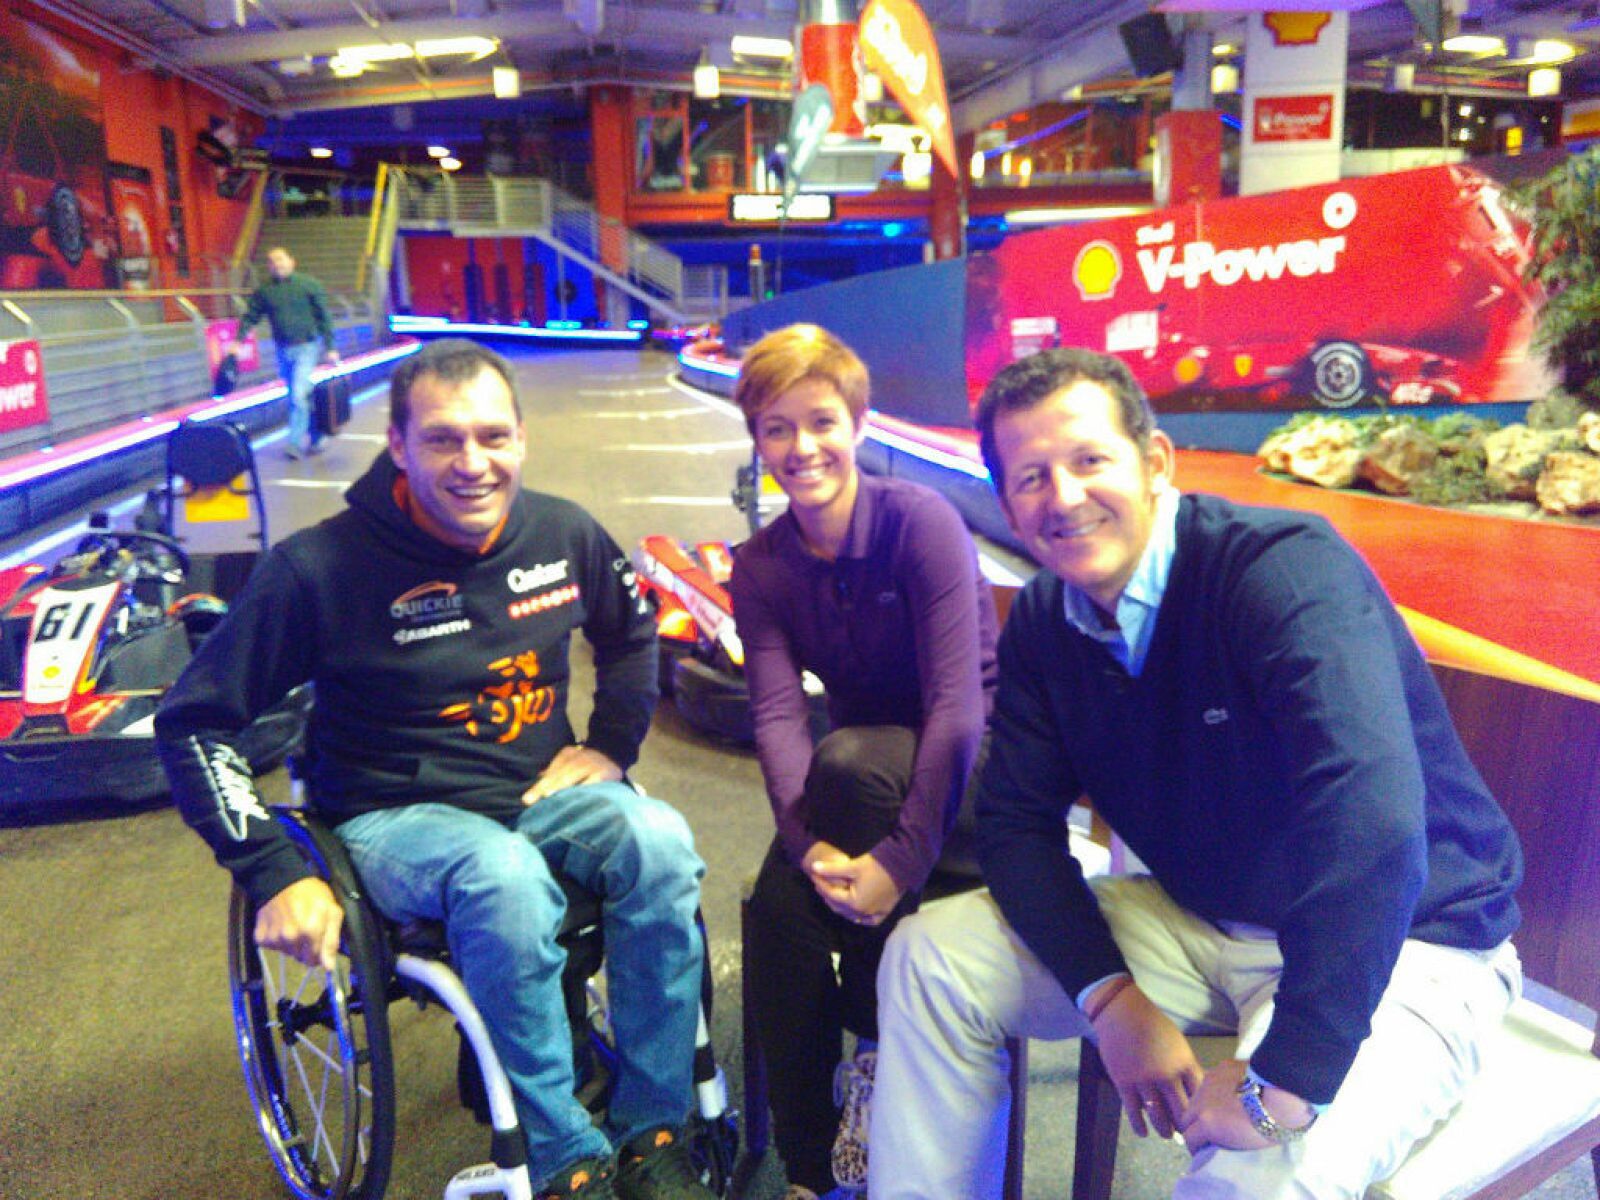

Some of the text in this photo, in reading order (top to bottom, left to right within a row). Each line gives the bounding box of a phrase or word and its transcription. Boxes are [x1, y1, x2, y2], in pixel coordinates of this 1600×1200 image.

[1136, 236, 1346, 293] V-Power
[34, 602, 97, 643] 61
[390, 594, 464, 618] QUICKIE
